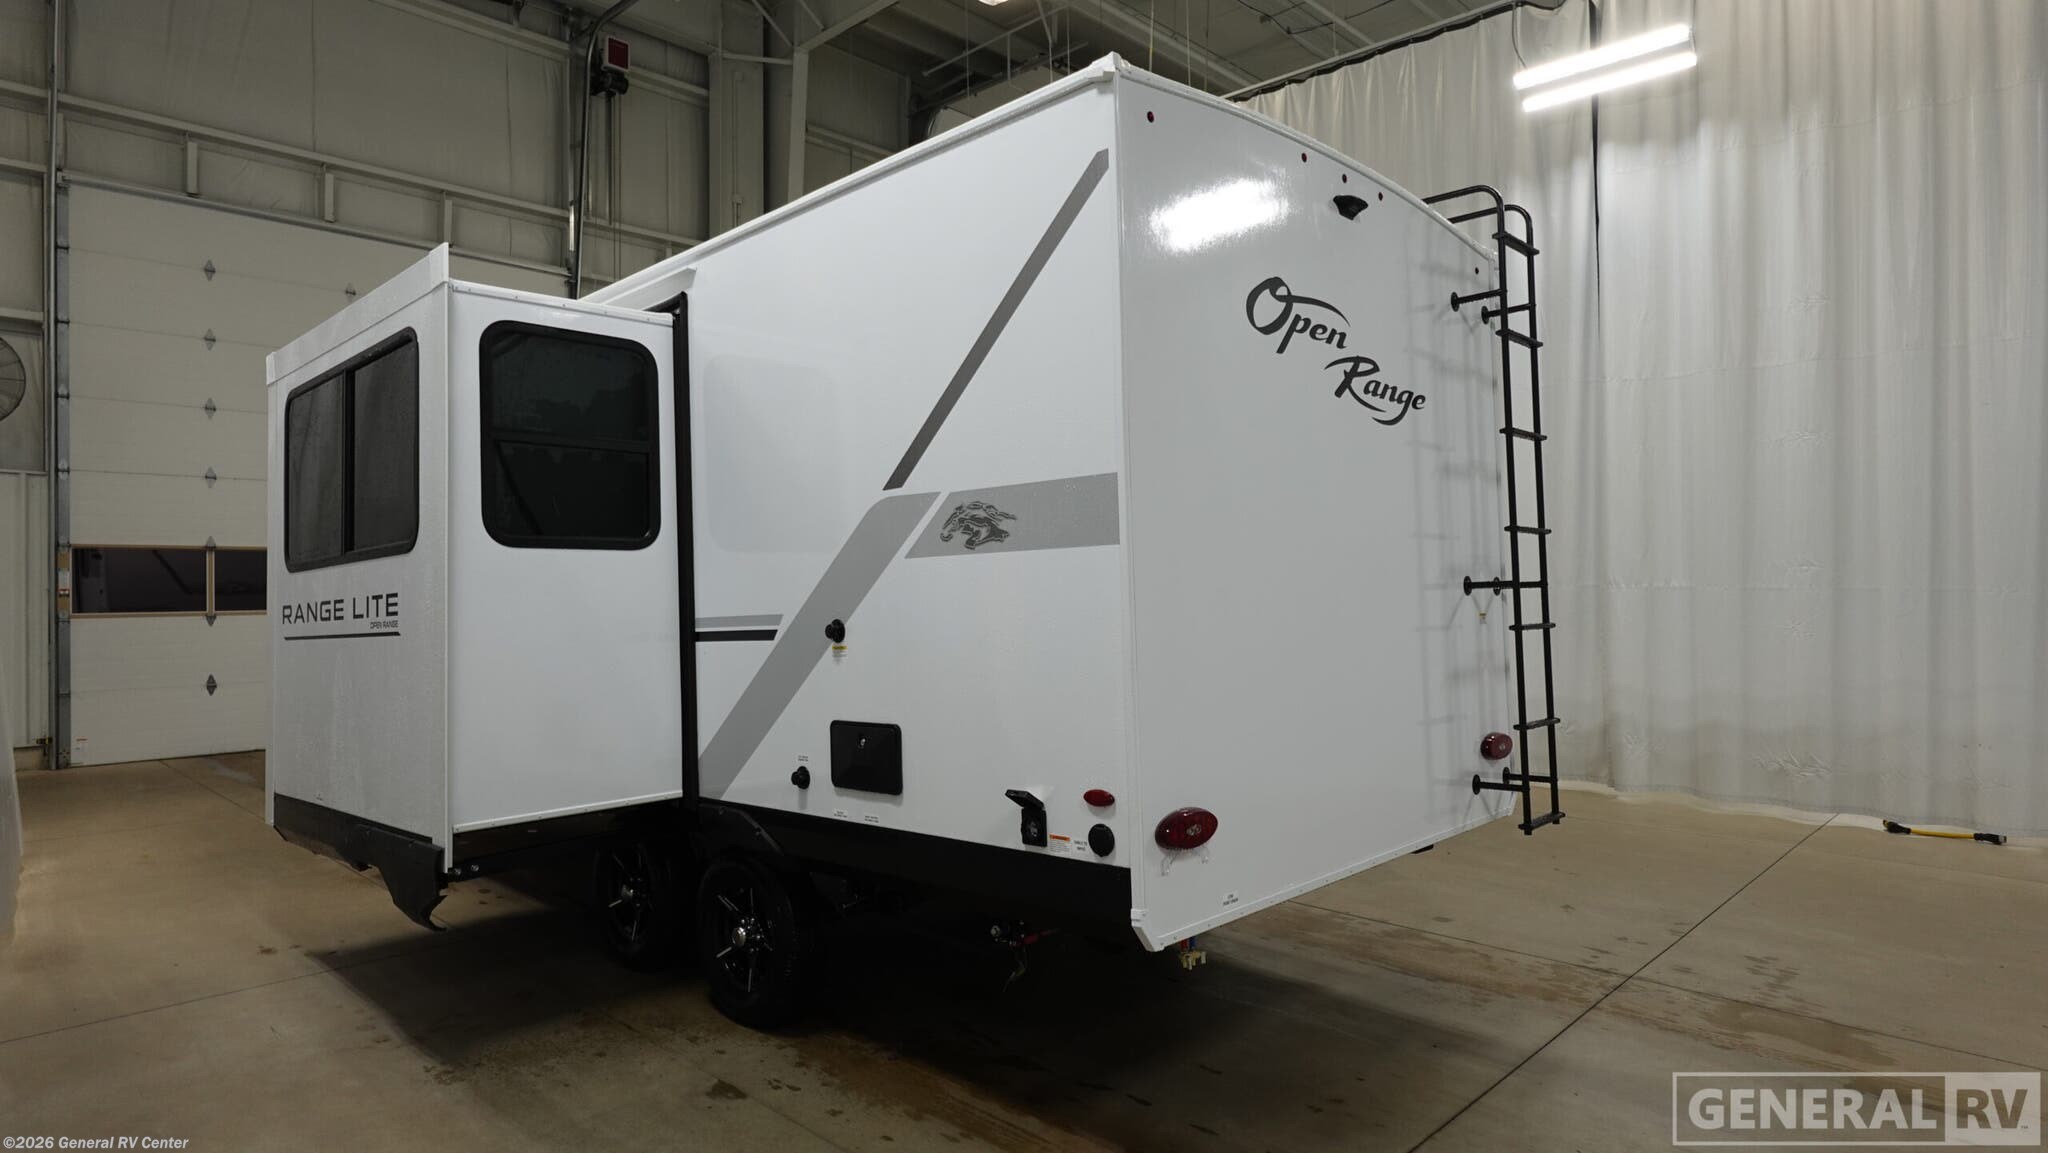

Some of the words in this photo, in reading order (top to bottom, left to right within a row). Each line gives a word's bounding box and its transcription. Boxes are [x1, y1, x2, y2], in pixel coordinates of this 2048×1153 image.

[1246, 276, 1351, 354] Open
[1324, 355, 1426, 426] Range
[282, 599, 344, 625] RANGE
[353, 592, 398, 619] LITE
[383, 620, 399, 629] RANGE
